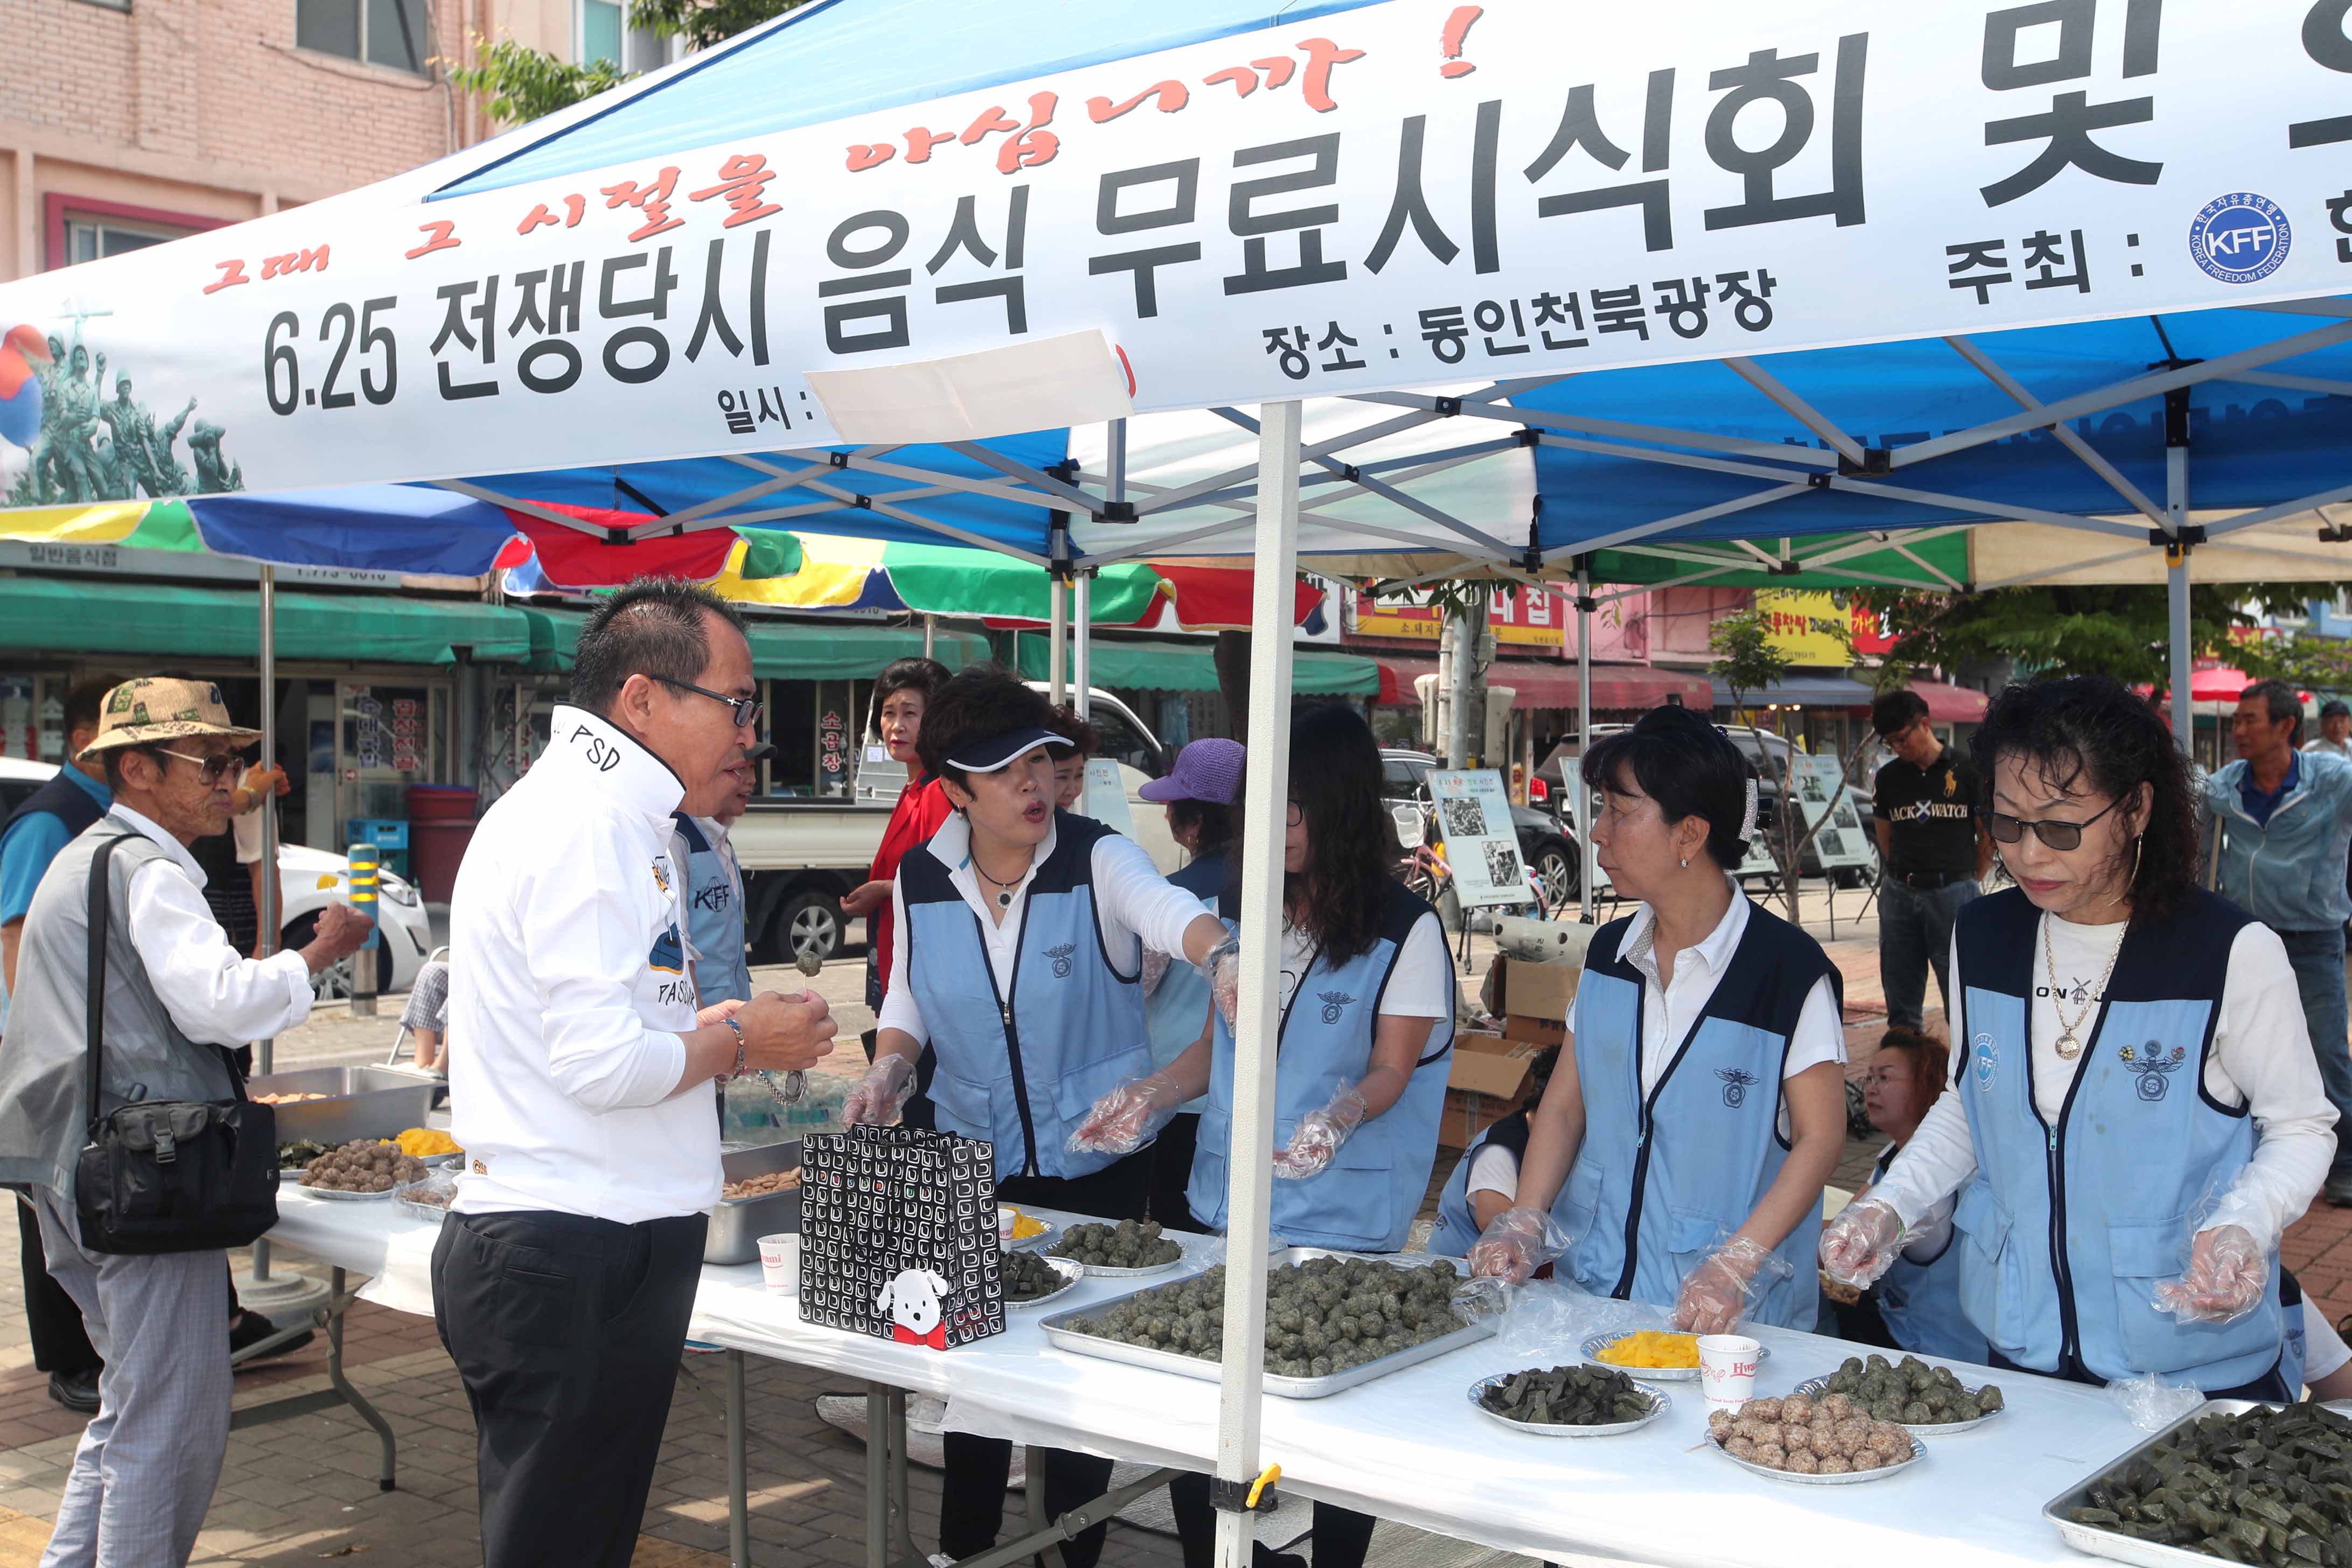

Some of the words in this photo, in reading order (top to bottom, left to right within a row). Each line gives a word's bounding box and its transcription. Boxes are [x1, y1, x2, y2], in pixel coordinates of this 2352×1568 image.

[202, 242, 330, 295] 그때
[404, 220, 463, 260] 그
[516, 154, 784, 242] 시절을
[264, 294, 399, 417] 6.25
[429, 229, 772, 401] 전쟁당시
[818, 184, 1030, 355] 음식
[1087, 31, 1869, 318] 무료시식회
[1979, 0, 2165, 208] 및
[2196, 194, 2278, 225] 한국자유총연맹
[2191, 234, 2208, 268] KOREA
[2206, 264, 2257, 283] FREEDOM
[2257, 222, 2291, 278] FEDERATION
[2207, 225, 2273, 257] KFF
[1944, 229, 2091, 305] 주최
[1263, 320, 1366, 381] 장소
[1417, 268, 1779, 365] 동인천북광장
[717, 386, 790, 435] 일시
[29, 545, 117, 567] 일반음식점
[570, 724, 621, 772] PSD
[821, 710, 842, 772] 소곱창
[1931, 803, 1968, 818] WATCH
[694, 884, 730, 910] KFF
